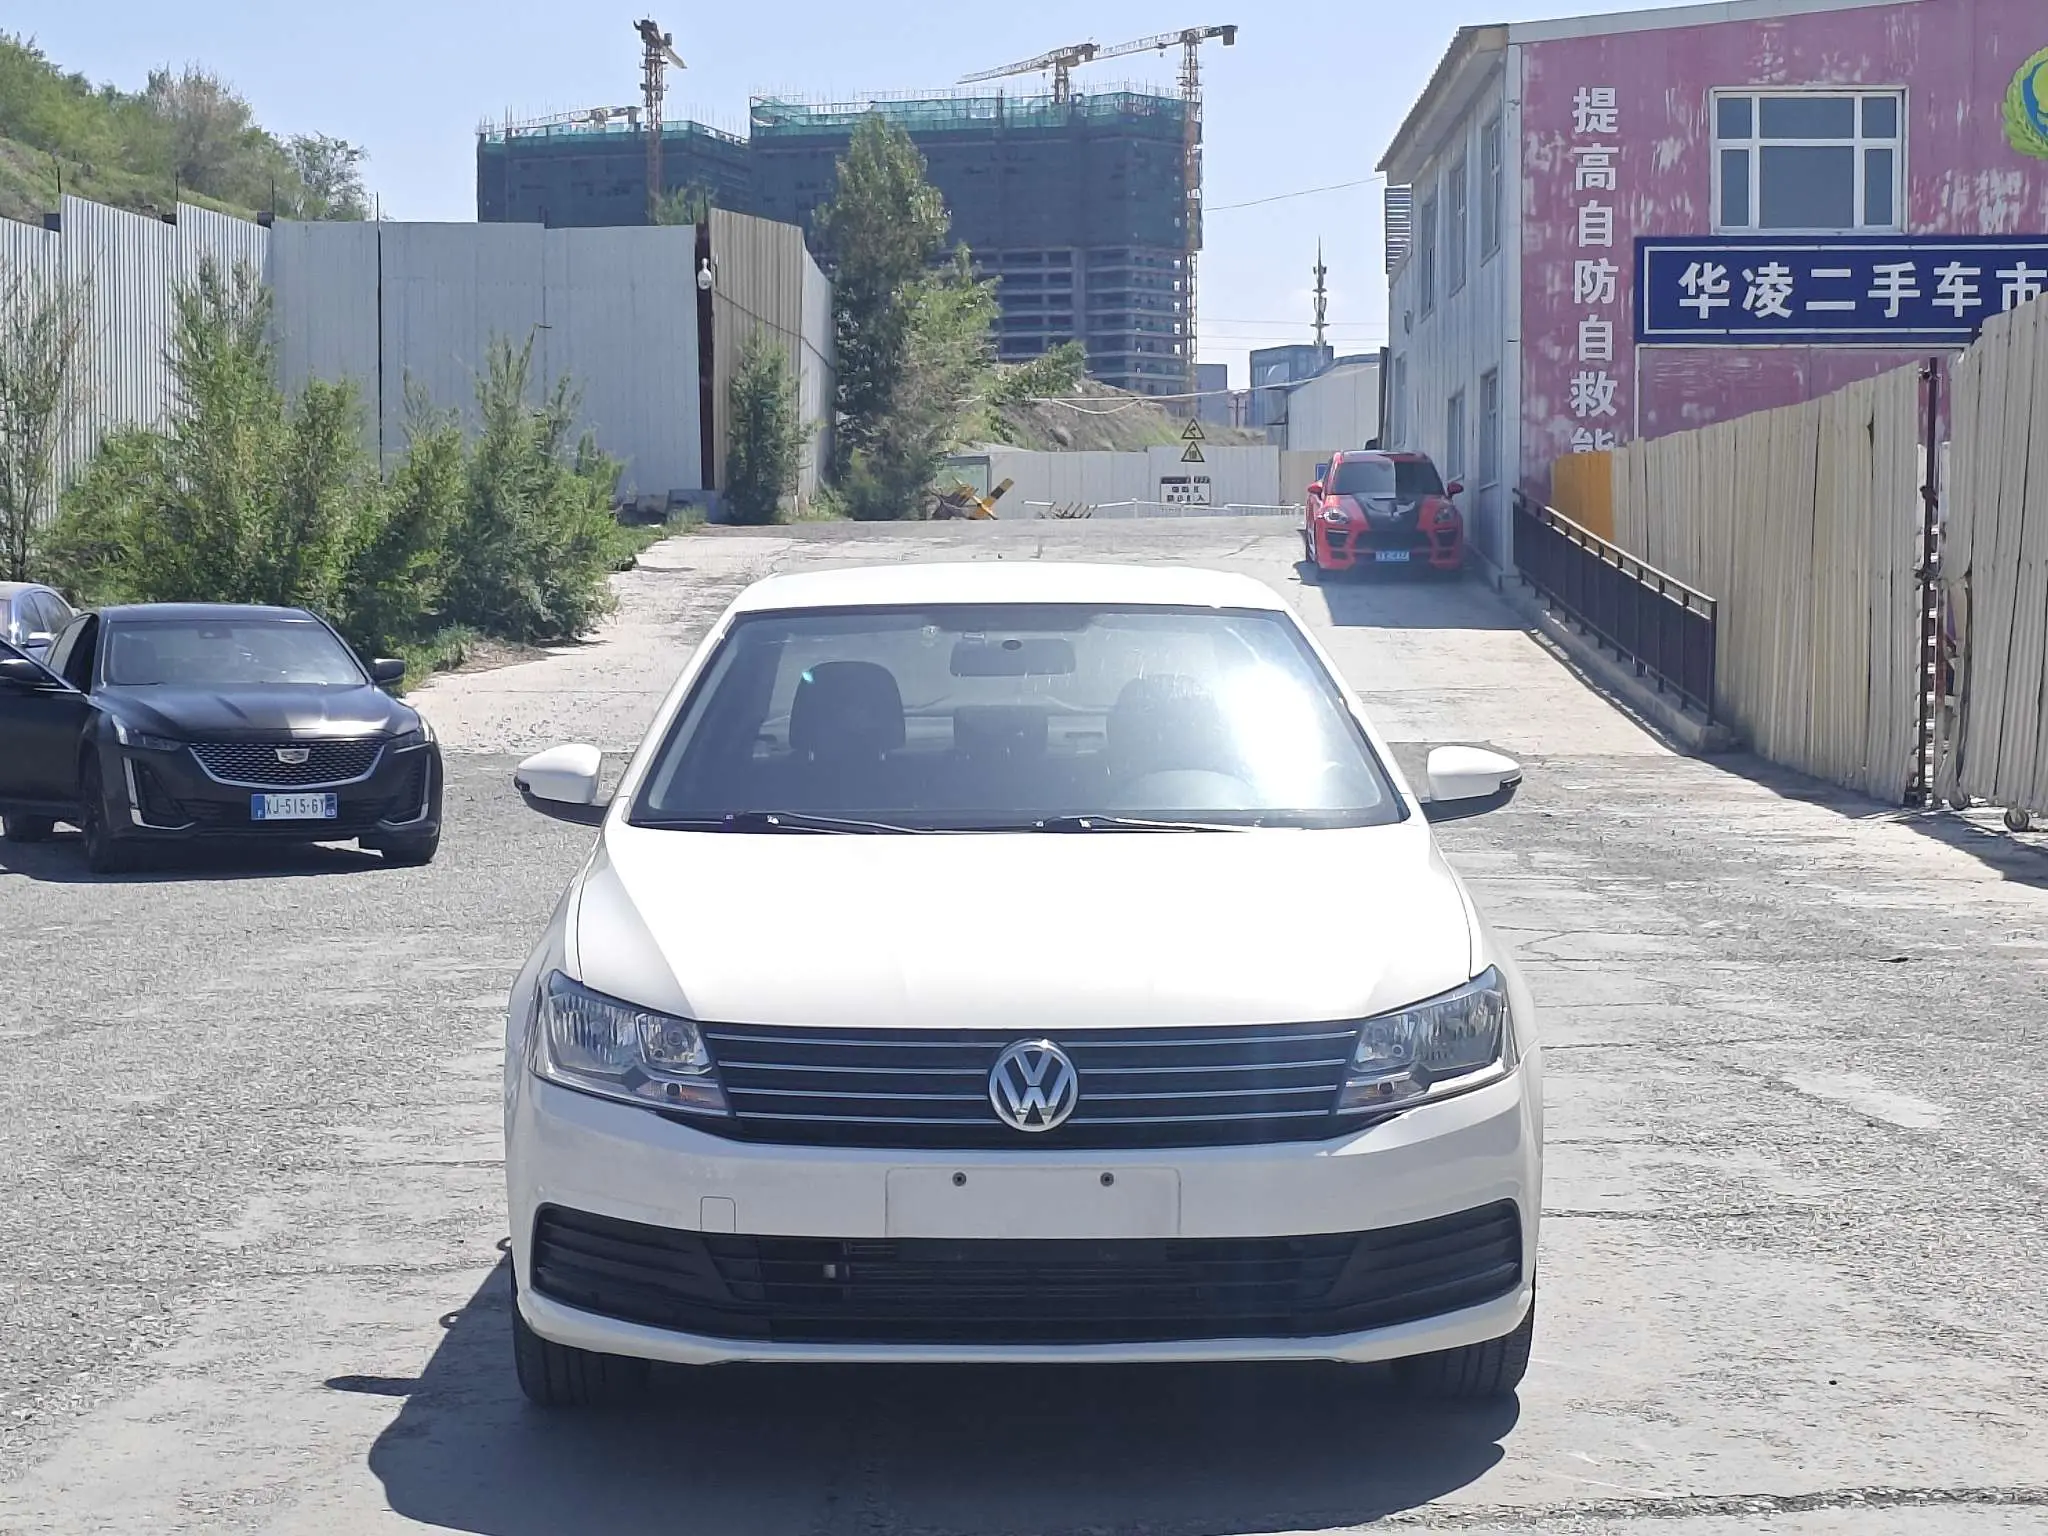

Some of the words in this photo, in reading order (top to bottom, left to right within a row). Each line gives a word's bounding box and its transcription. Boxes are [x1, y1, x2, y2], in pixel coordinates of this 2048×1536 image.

[1677, 260, 2048, 320] 华凌二手车市
[988, 1038, 1079, 1132] VW
